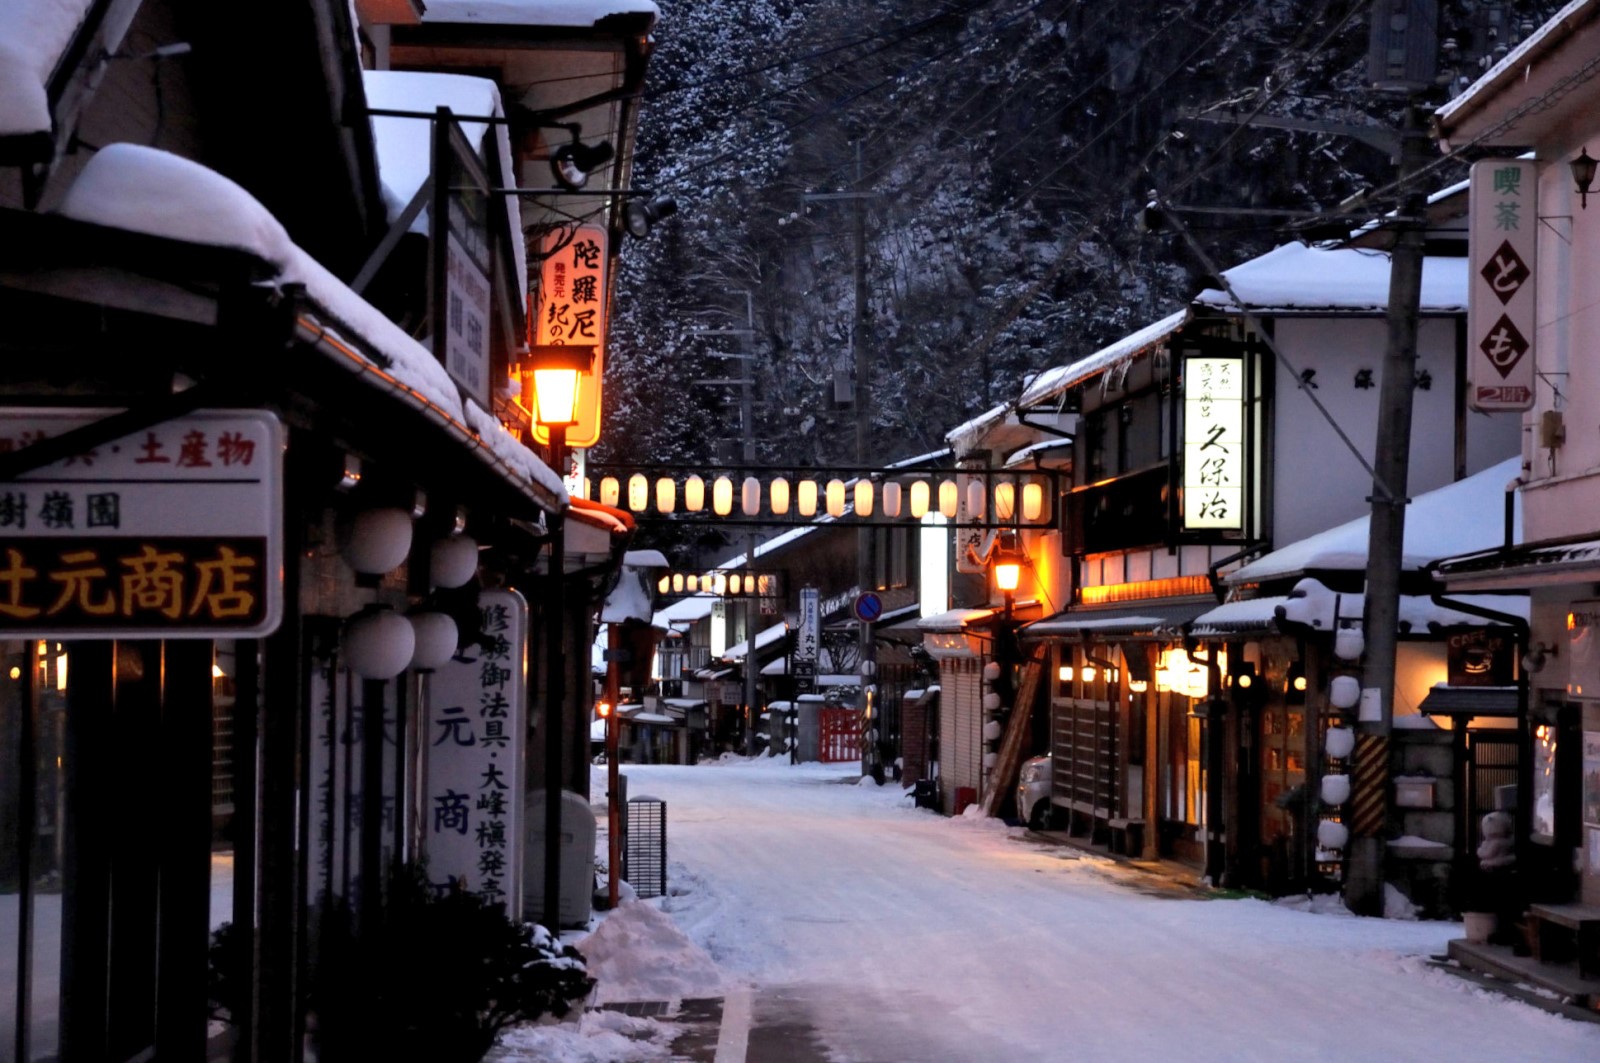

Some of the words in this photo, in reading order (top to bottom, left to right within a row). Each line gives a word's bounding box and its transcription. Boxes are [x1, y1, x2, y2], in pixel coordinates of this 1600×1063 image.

[1493, 166, 1521, 232] 喫茶
[554, 262, 566, 298] 発売元
[568, 238, 601, 364] 陀羅尼
[1489, 253, 1519, 367] とも
[1199, 423, 1229, 519] 久保治
